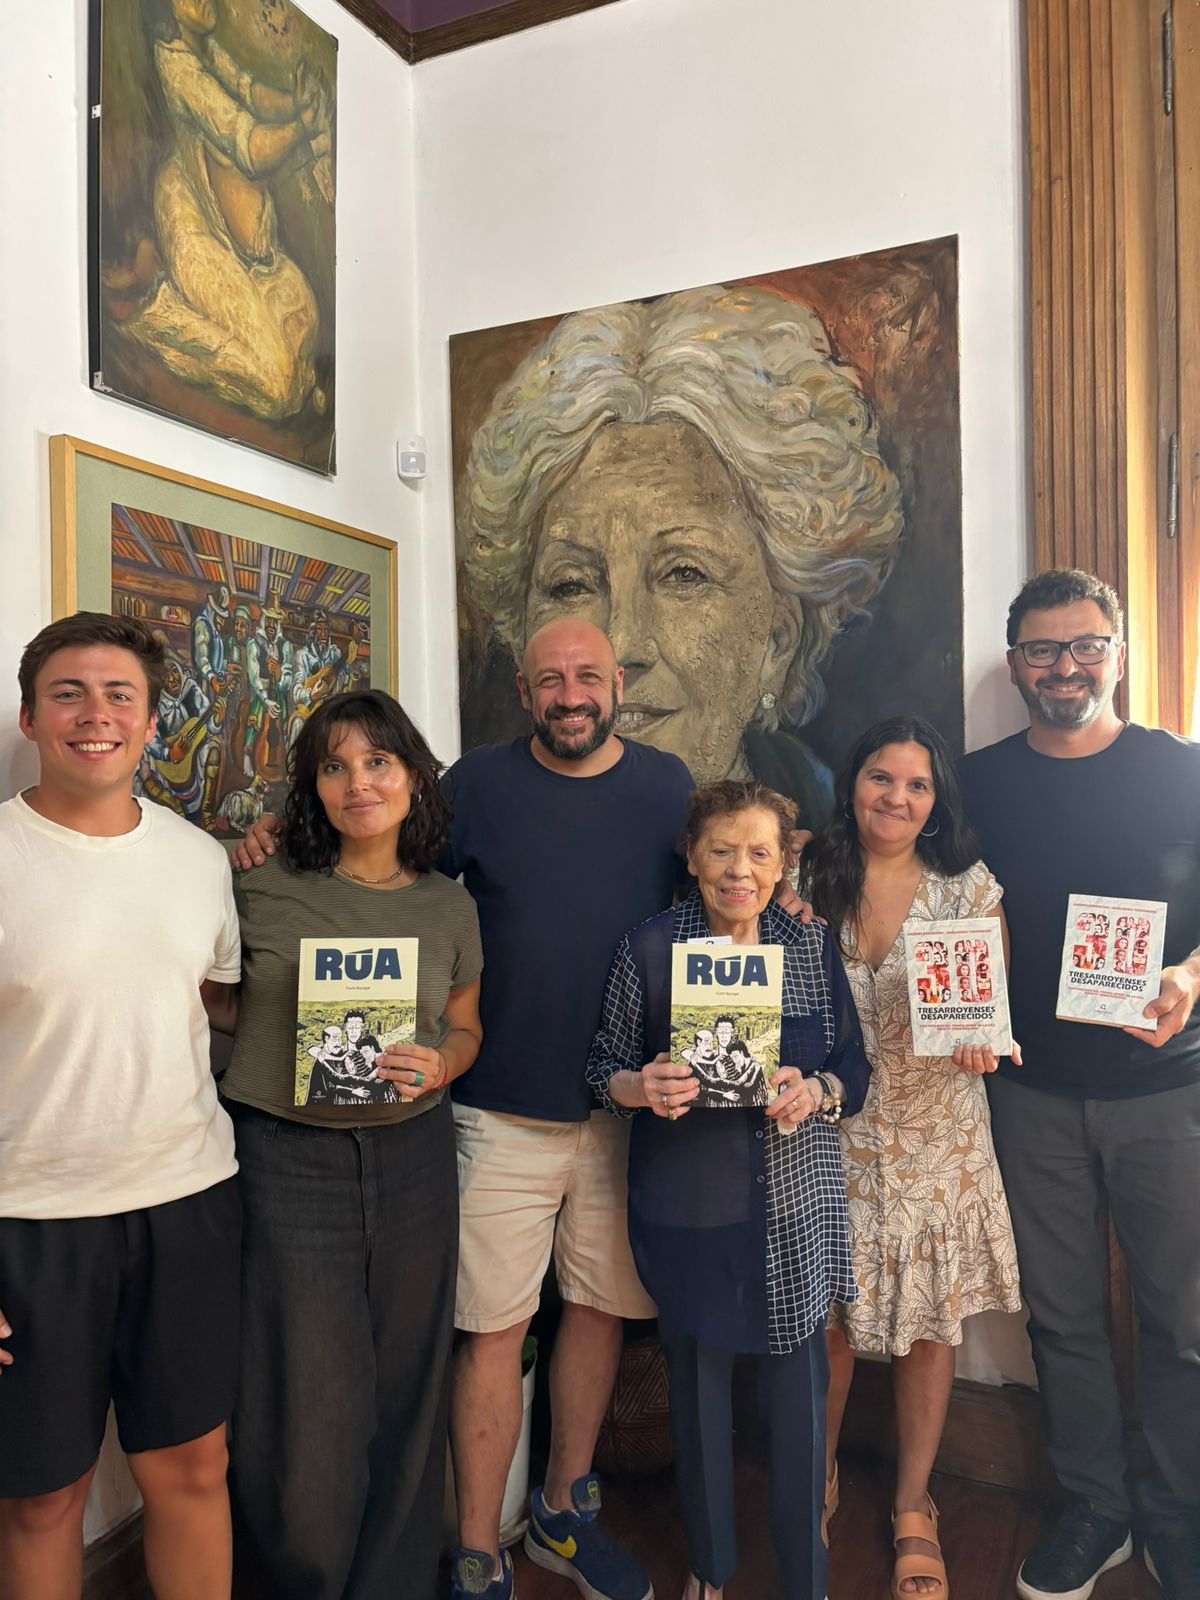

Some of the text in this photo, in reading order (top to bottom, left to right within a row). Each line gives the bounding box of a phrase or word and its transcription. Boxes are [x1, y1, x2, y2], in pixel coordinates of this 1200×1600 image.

[315, 948, 402, 981] RÚA
[686, 953, 769, 986] RÚA
[1068, 970, 1148, 987] TRESARROYENSES
[1070, 977, 1144, 992] DESAPARECIDOS
[918, 1006, 996, 1014] TRESARROYENSES
[920, 1013, 993, 1021] DESAPARECIDOS
